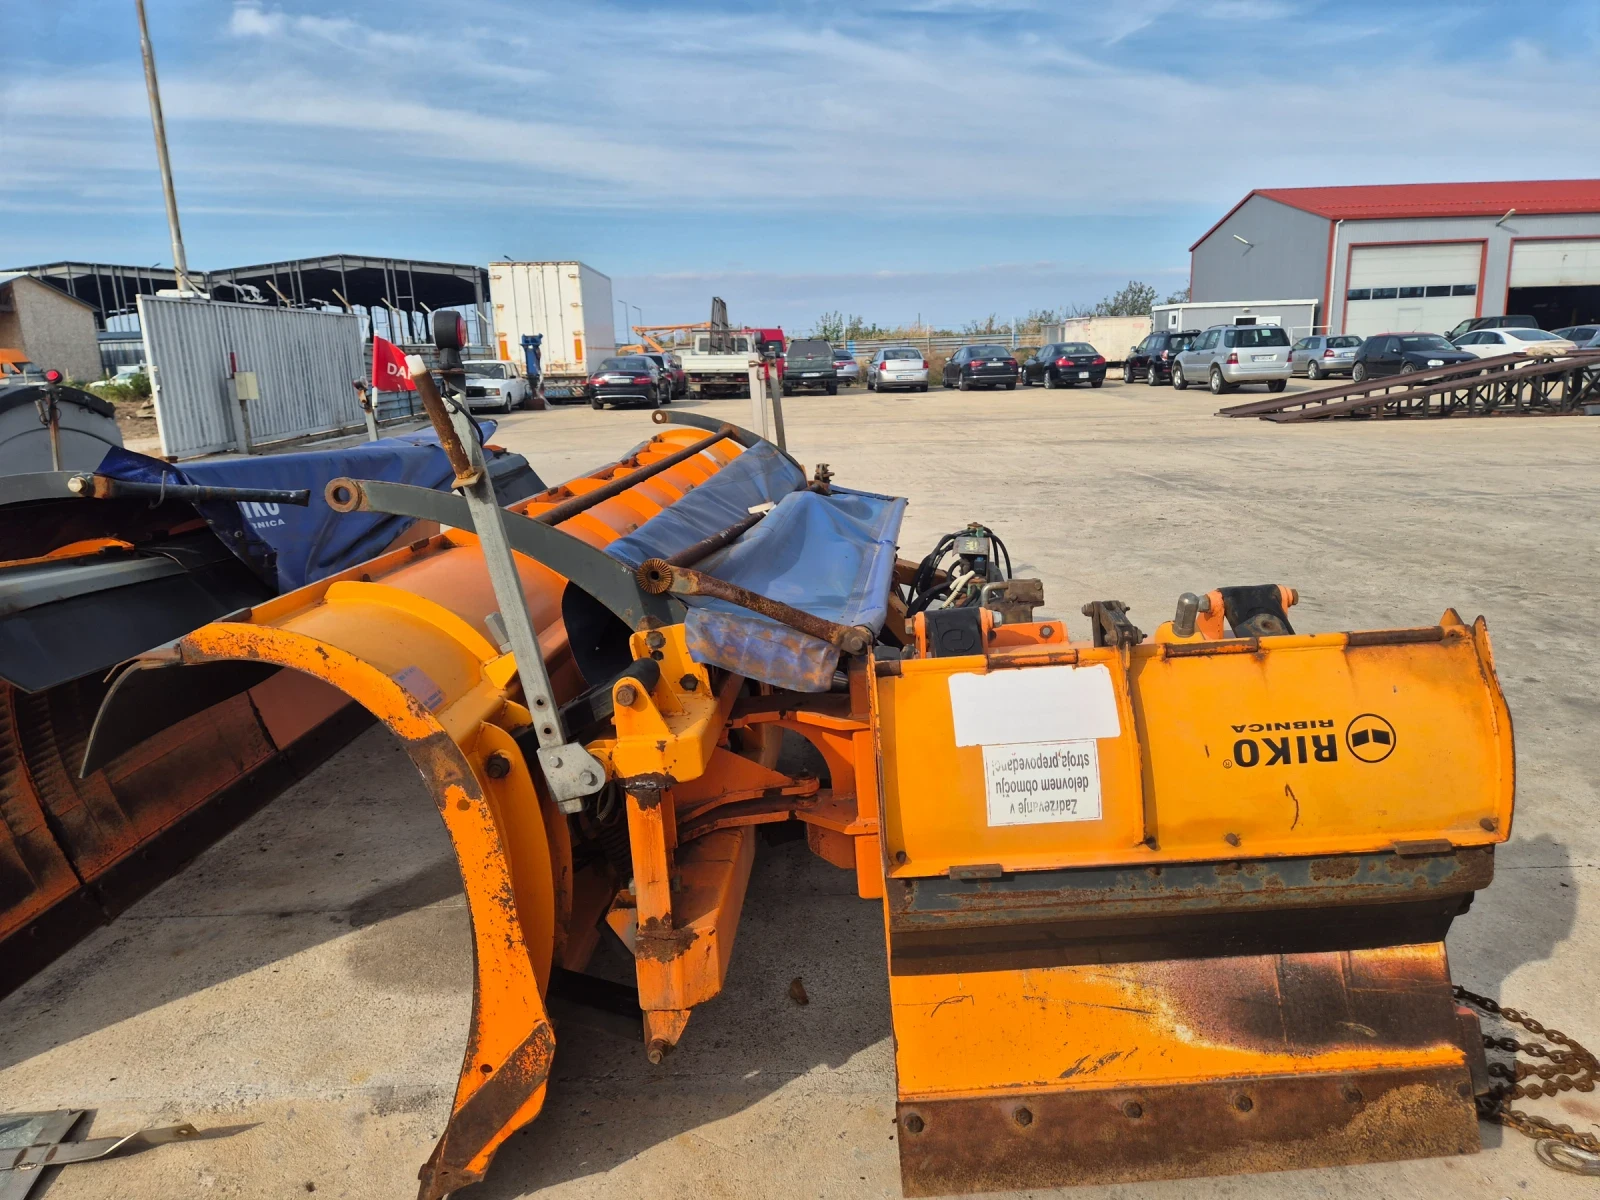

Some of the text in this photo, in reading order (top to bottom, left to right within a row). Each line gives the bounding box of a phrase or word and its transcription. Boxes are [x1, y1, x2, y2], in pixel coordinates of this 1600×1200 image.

[1230, 719, 1335, 734] RIBNICA
[1232, 733, 1339, 768] RIKO
[995, 776, 1089, 798] delovnem območju
[1009, 797, 1078, 818] Zadrževanje v
